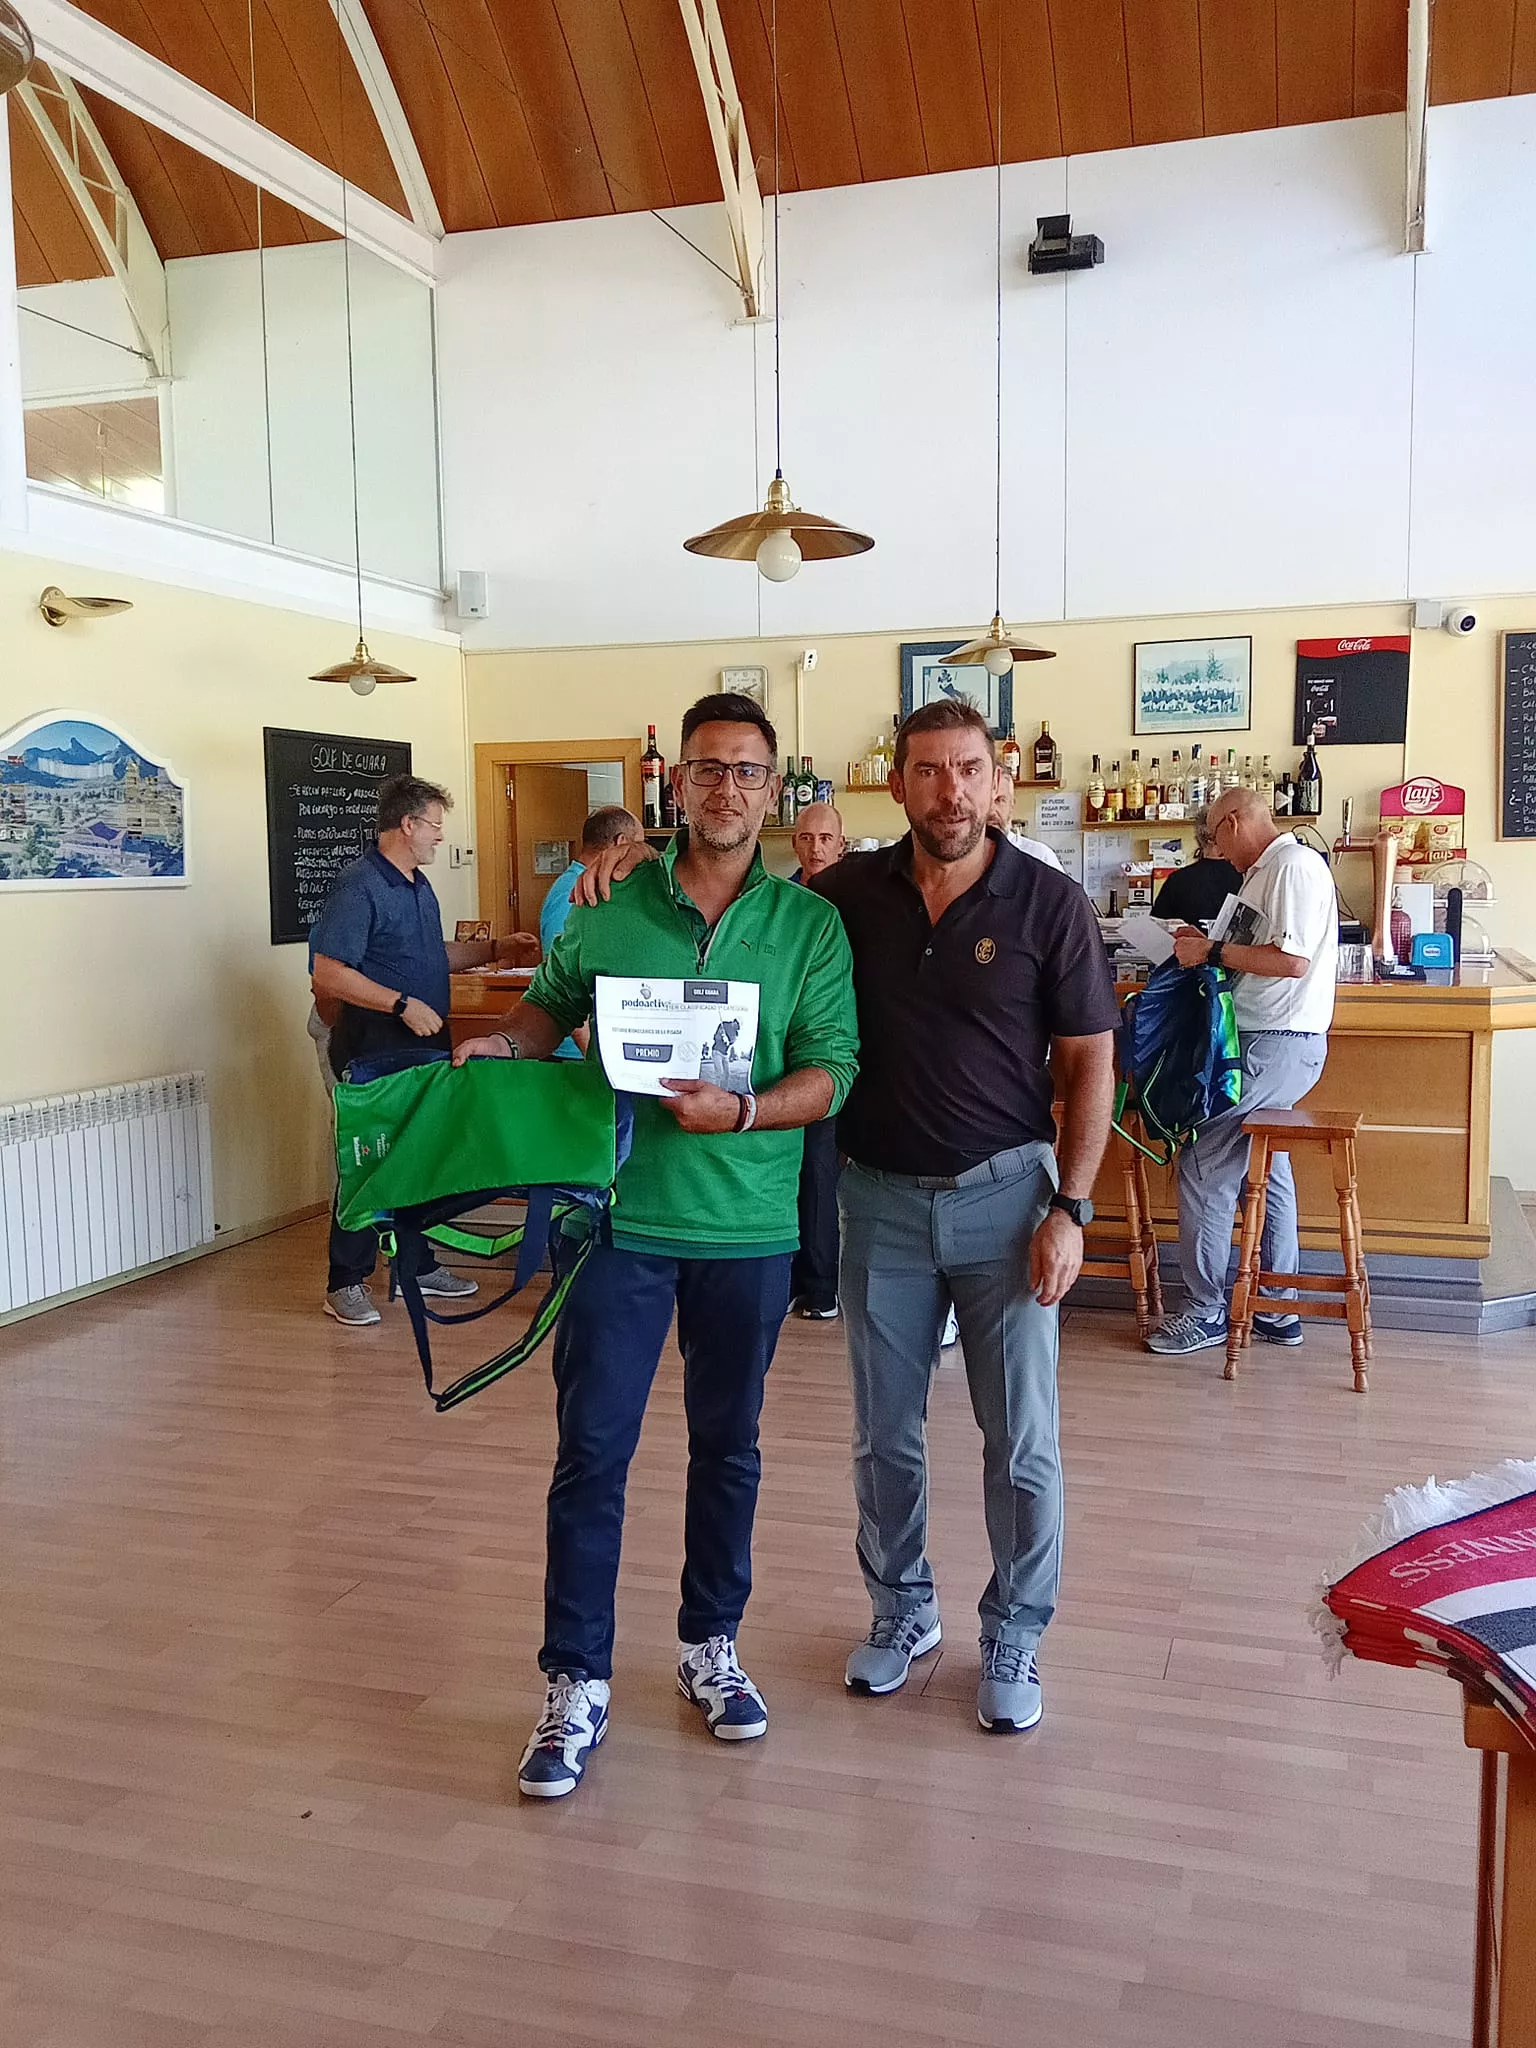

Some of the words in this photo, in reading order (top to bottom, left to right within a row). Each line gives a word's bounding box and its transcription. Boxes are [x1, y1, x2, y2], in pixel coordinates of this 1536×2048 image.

[1337, 638, 1372, 651] Coca-Cola
[310, 743, 337, 768] GOLF
[342, 751, 353, 768] DE
[355, 754, 386, 771] GUARA
[1404, 785, 1441, 806] Lay's
[635, 1047, 660, 1058] PREMIO
[1389, 1526, 1536, 1583] NNESS
